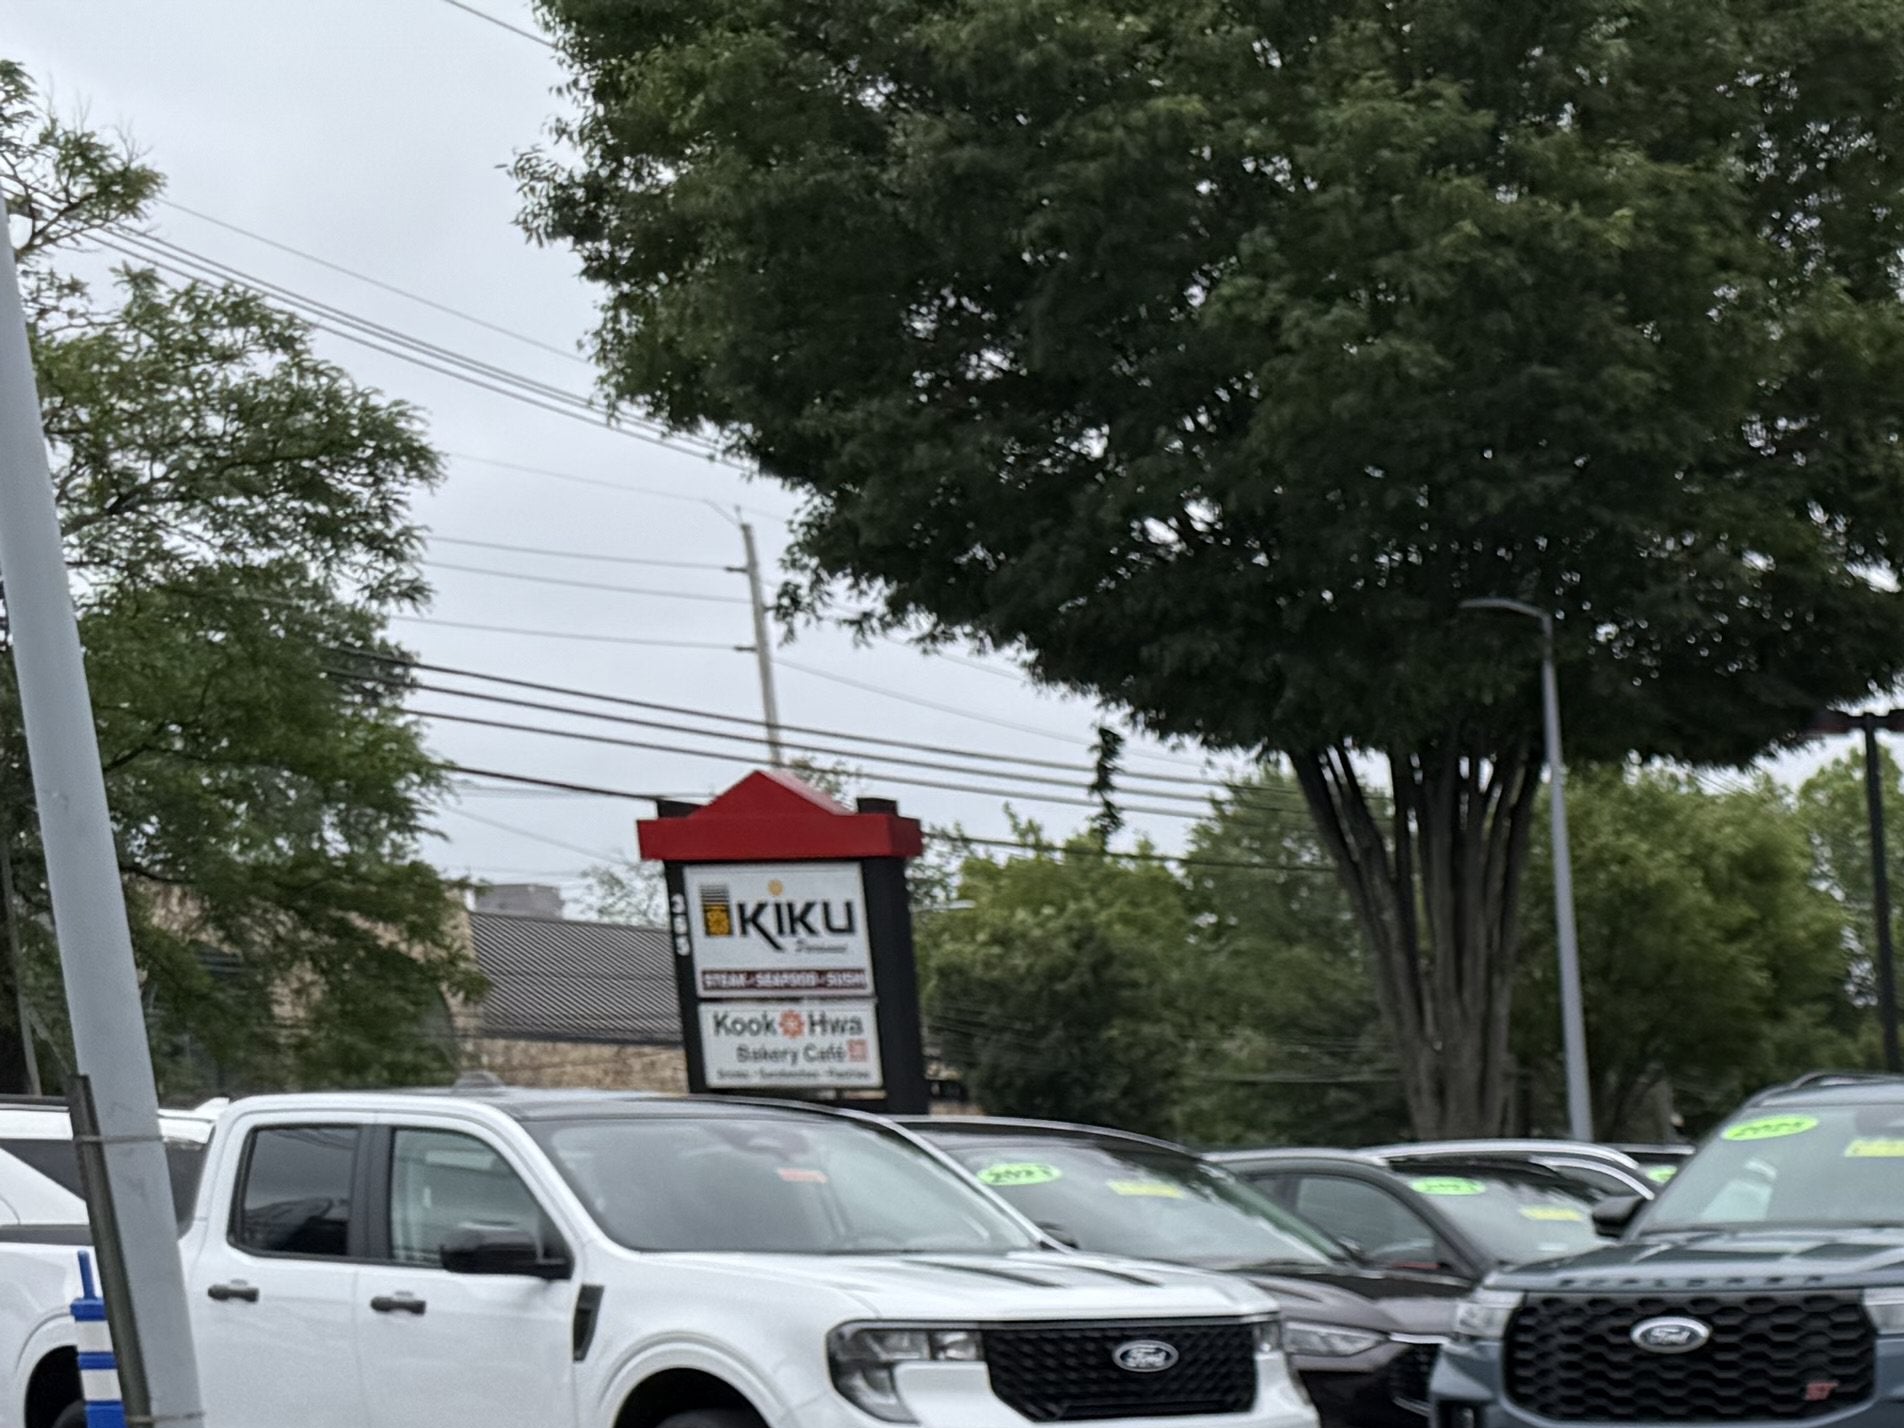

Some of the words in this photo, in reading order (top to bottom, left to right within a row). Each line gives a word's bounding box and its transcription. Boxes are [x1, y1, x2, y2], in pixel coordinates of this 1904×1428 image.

[713, 1010, 776, 1036] Kook
[808, 1010, 863, 1036] Hwa
[735, 1043, 798, 1066] Bakery
